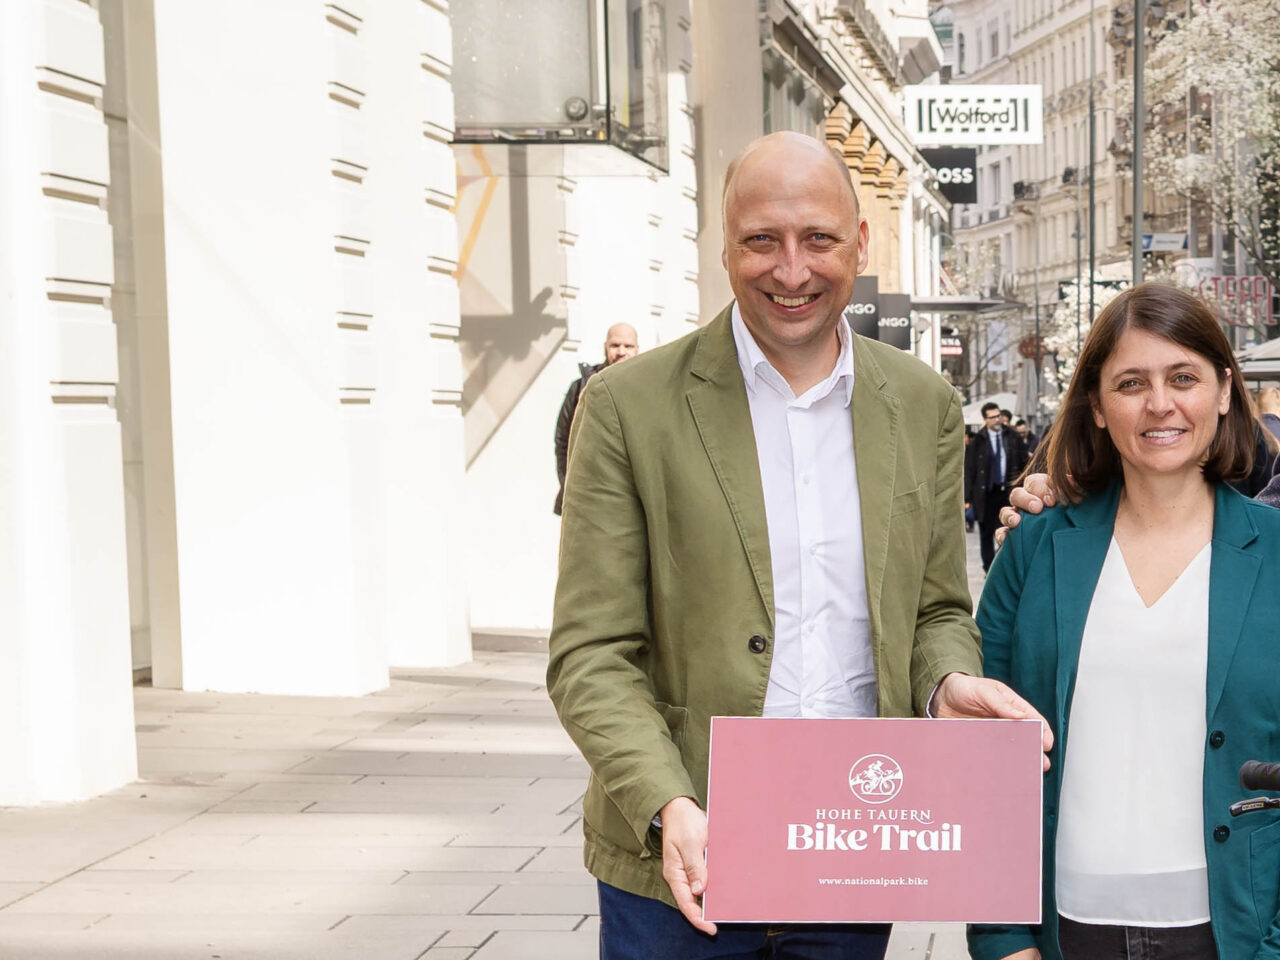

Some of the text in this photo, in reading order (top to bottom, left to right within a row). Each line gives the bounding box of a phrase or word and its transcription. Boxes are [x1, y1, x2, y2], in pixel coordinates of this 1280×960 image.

[937, 107, 1009, 124] Wolford
[932, 167, 974, 184] OSS
[816, 809, 935, 825] HOHE TAUERN
[786, 822, 962, 851] Bike Trail
[818, 876, 929, 887] www.nationalpark.bike
